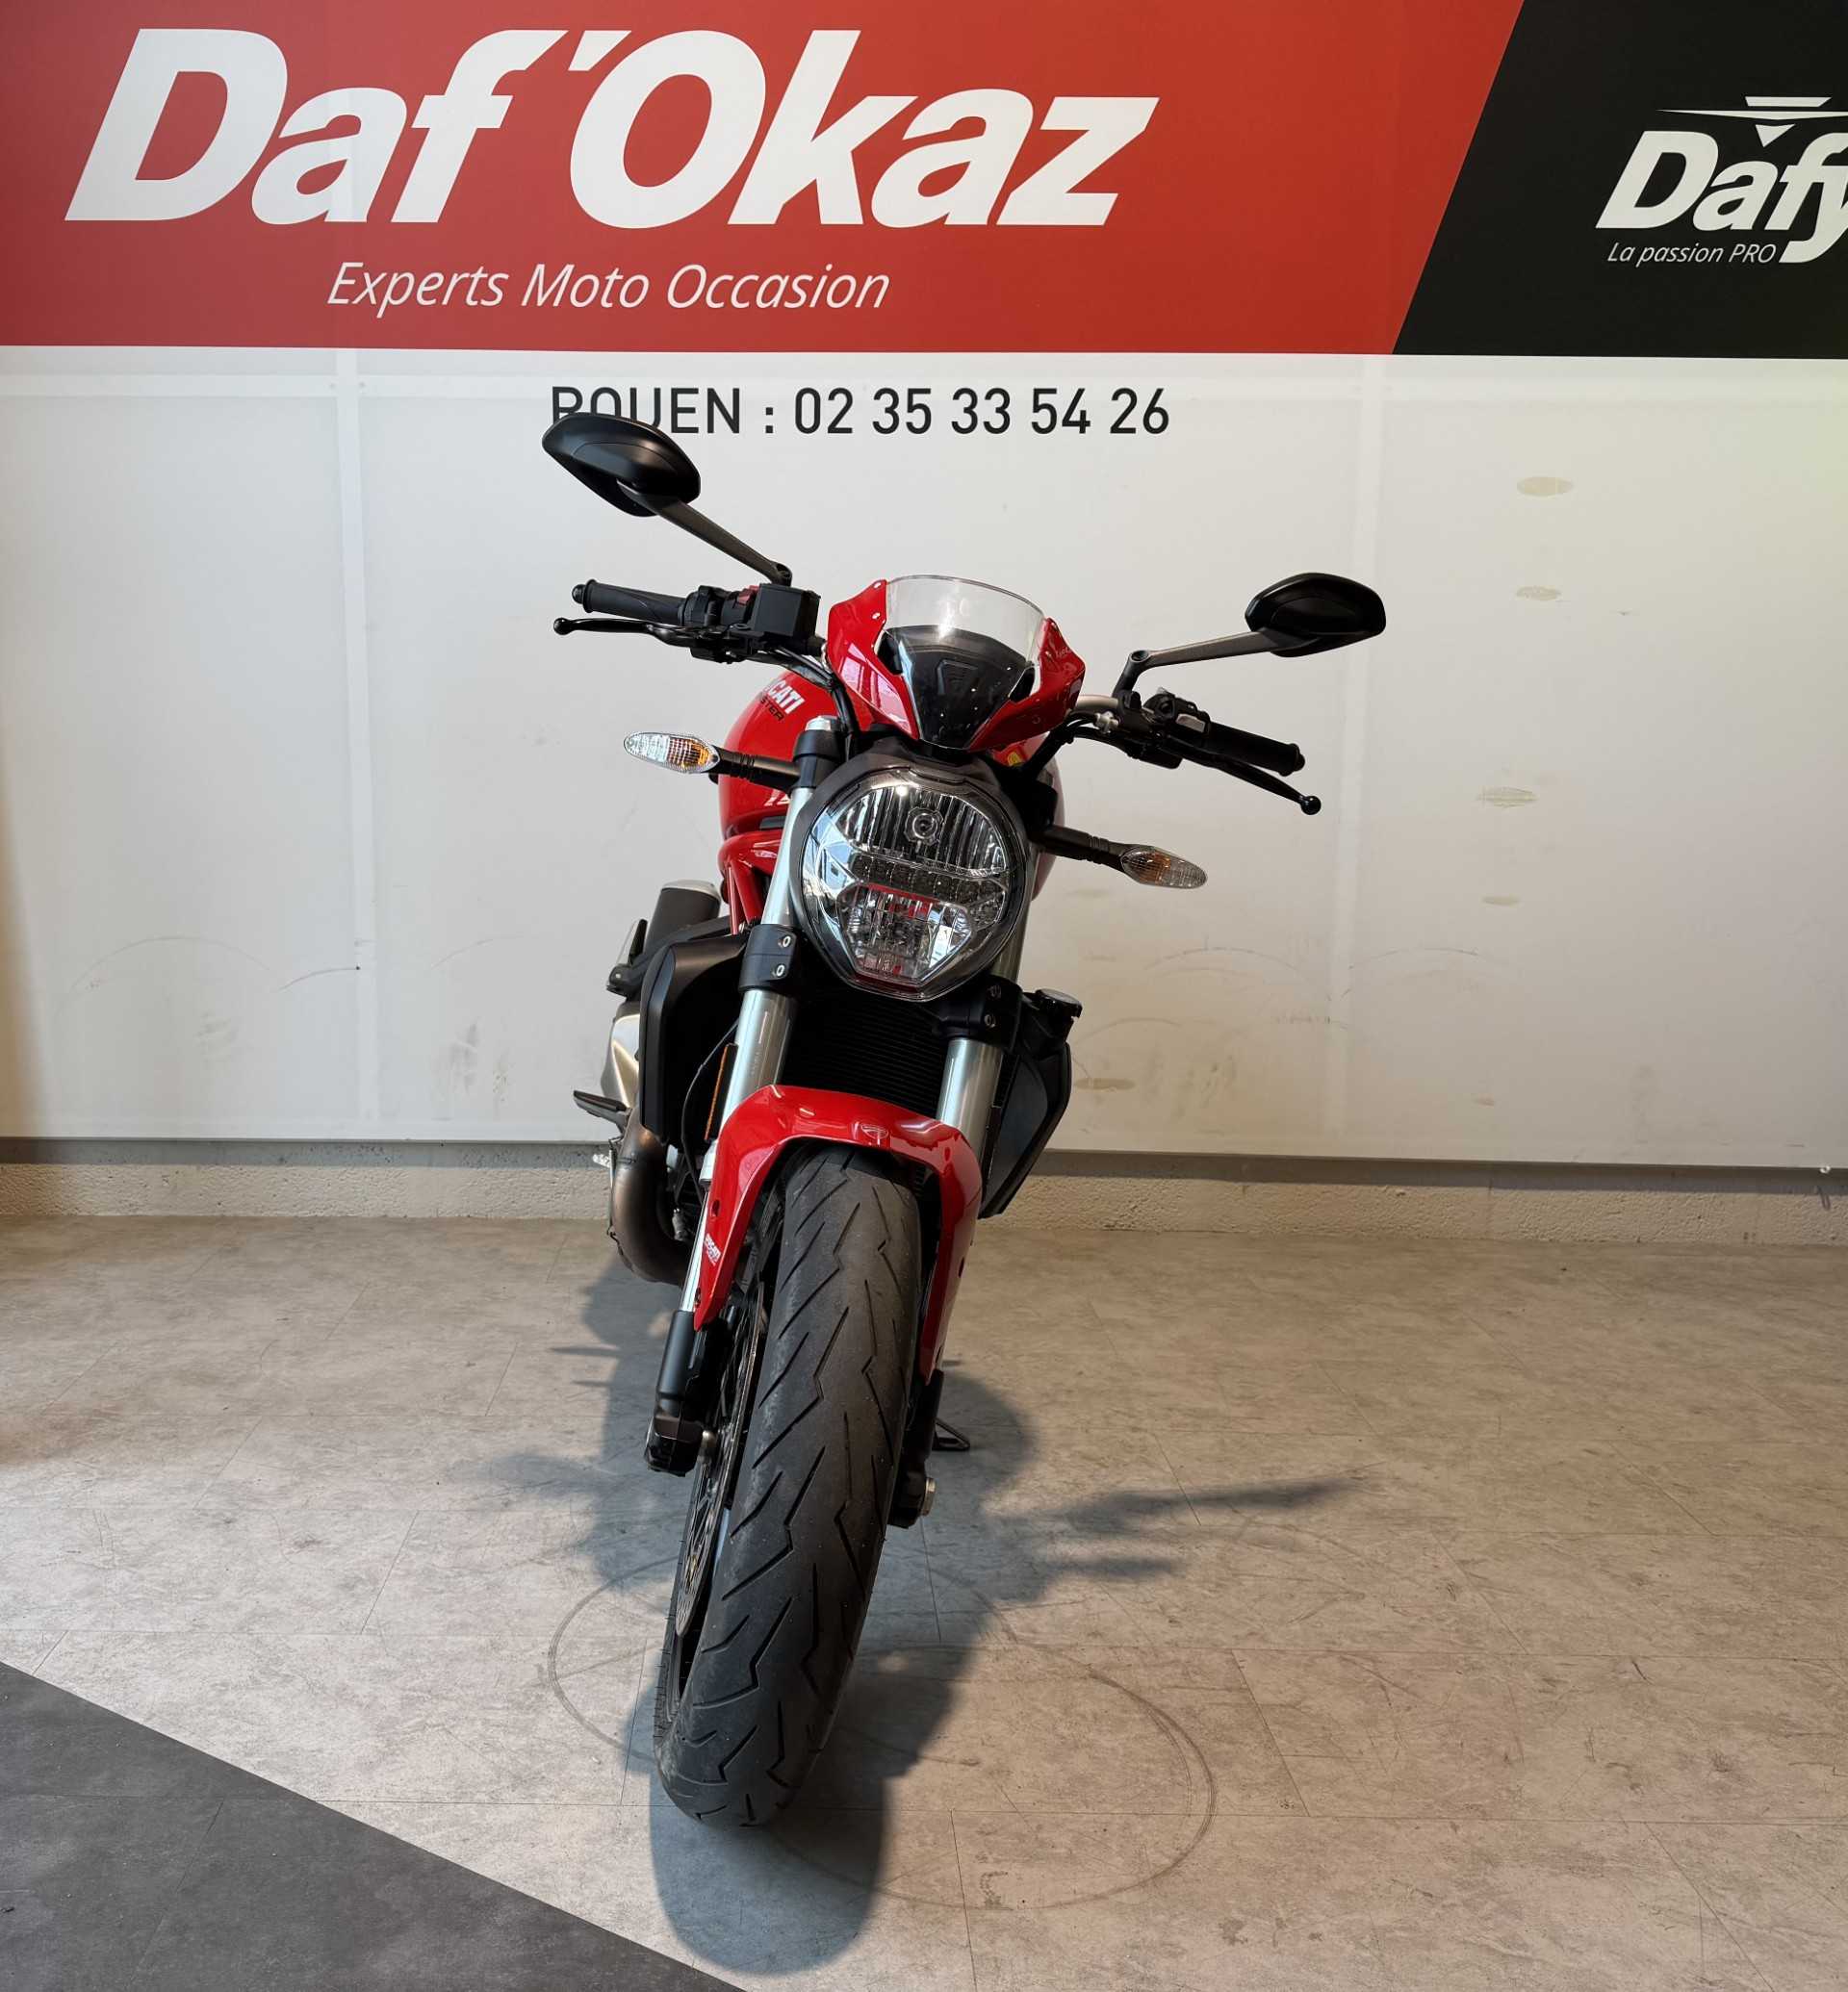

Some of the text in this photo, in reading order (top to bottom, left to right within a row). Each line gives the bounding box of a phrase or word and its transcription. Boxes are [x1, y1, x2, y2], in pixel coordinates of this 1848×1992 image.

[1595, 131, 1848, 264] Dafy
[1607, 243, 1777, 268] La passion PRO
[327, 262, 889, 319] Experts Moto Occasion
[552, 386, 740, 434] ROUEN
[795, 387, 854, 434] 02
[872, 387, 932, 434] 35
[951, 387, 1011, 434] 33
[1031, 387, 1091, 434] 54
[1110, 387, 1169, 434] 26
